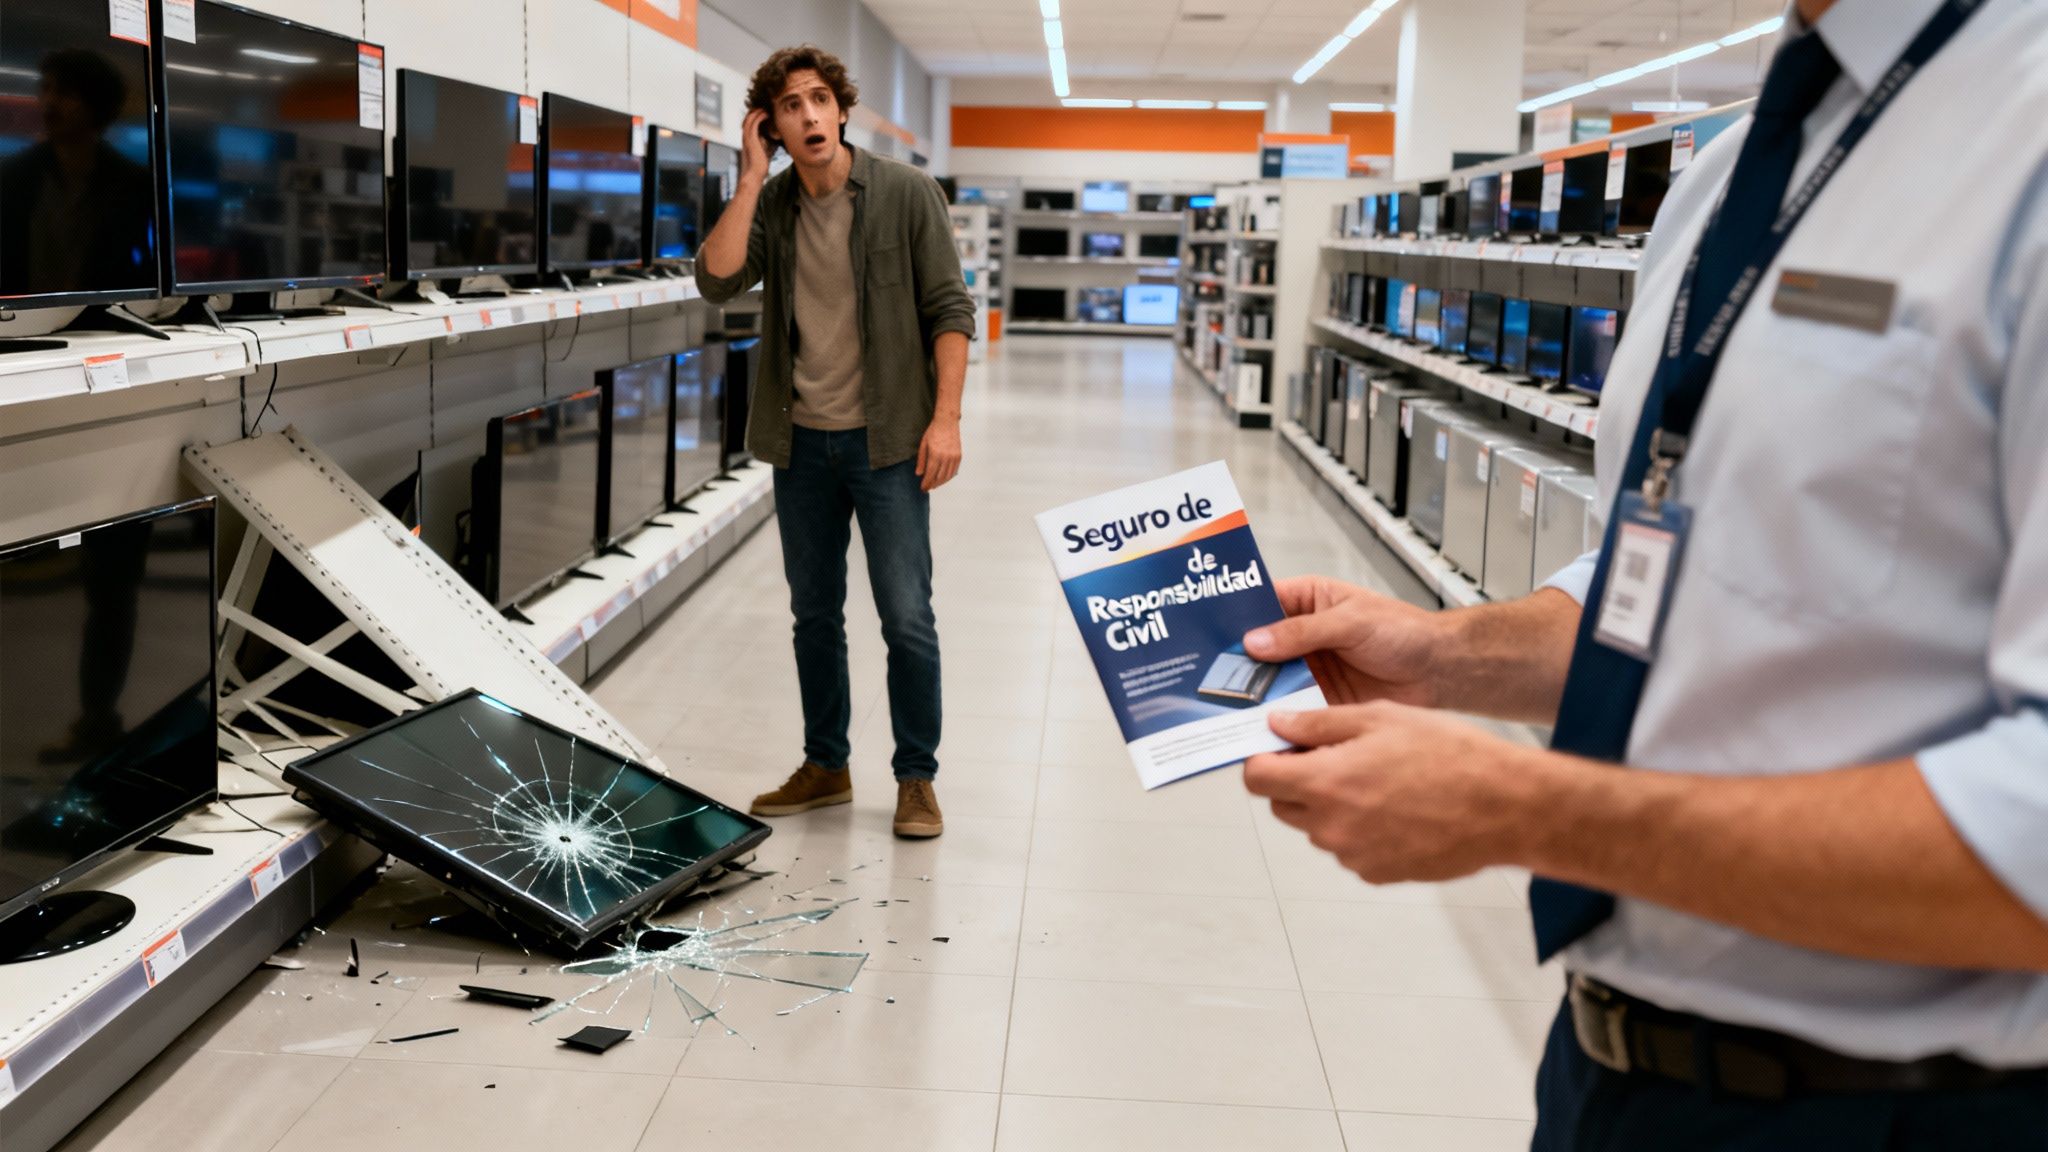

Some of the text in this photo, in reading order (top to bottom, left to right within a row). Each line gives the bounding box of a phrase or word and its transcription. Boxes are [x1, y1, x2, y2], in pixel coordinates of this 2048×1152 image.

[1063, 492, 1212, 553] Seguro de
[1188, 547, 1217, 573] de
[1105, 610, 1169, 651] Civil
